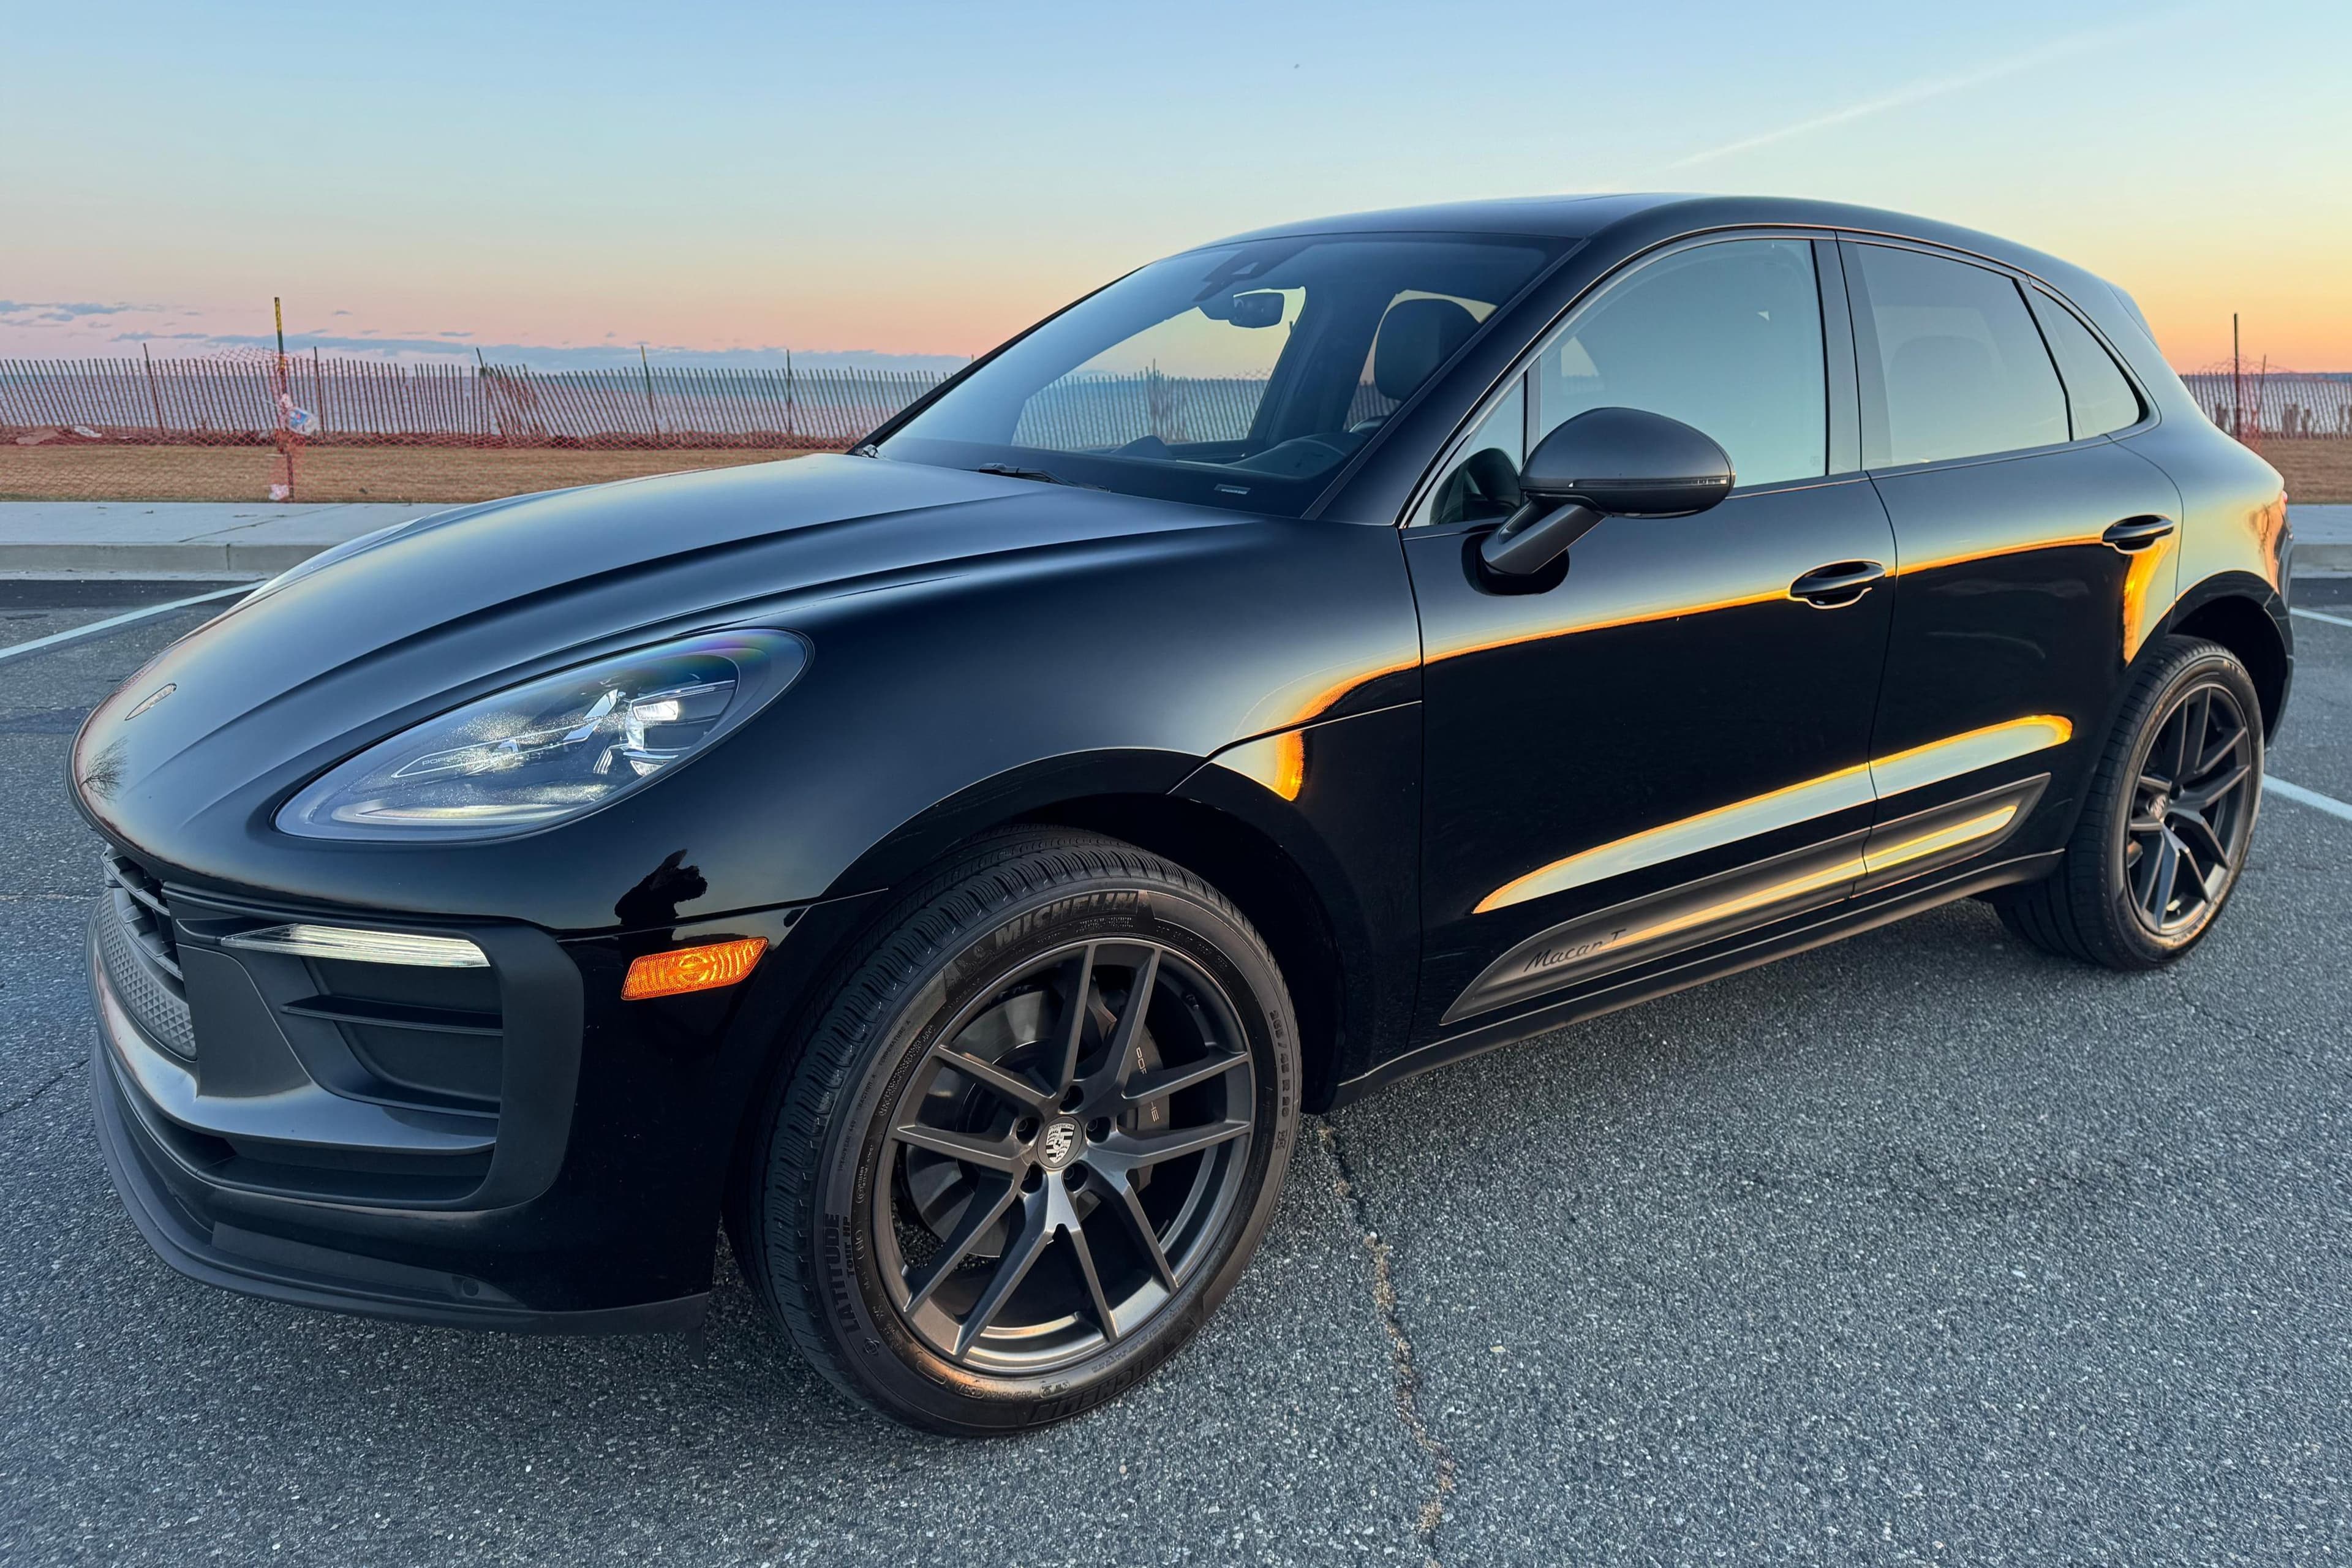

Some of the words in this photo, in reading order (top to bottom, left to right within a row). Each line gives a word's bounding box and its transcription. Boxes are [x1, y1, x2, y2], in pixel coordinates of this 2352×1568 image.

[995, 891, 1138, 949] MICHELIN
[1523, 940, 1603, 973] Macan
[1611, 929, 1626, 942] T
[1136, 1046, 1160, 1123] PORHE
[825, 1213, 861, 1333] LATITUDE
